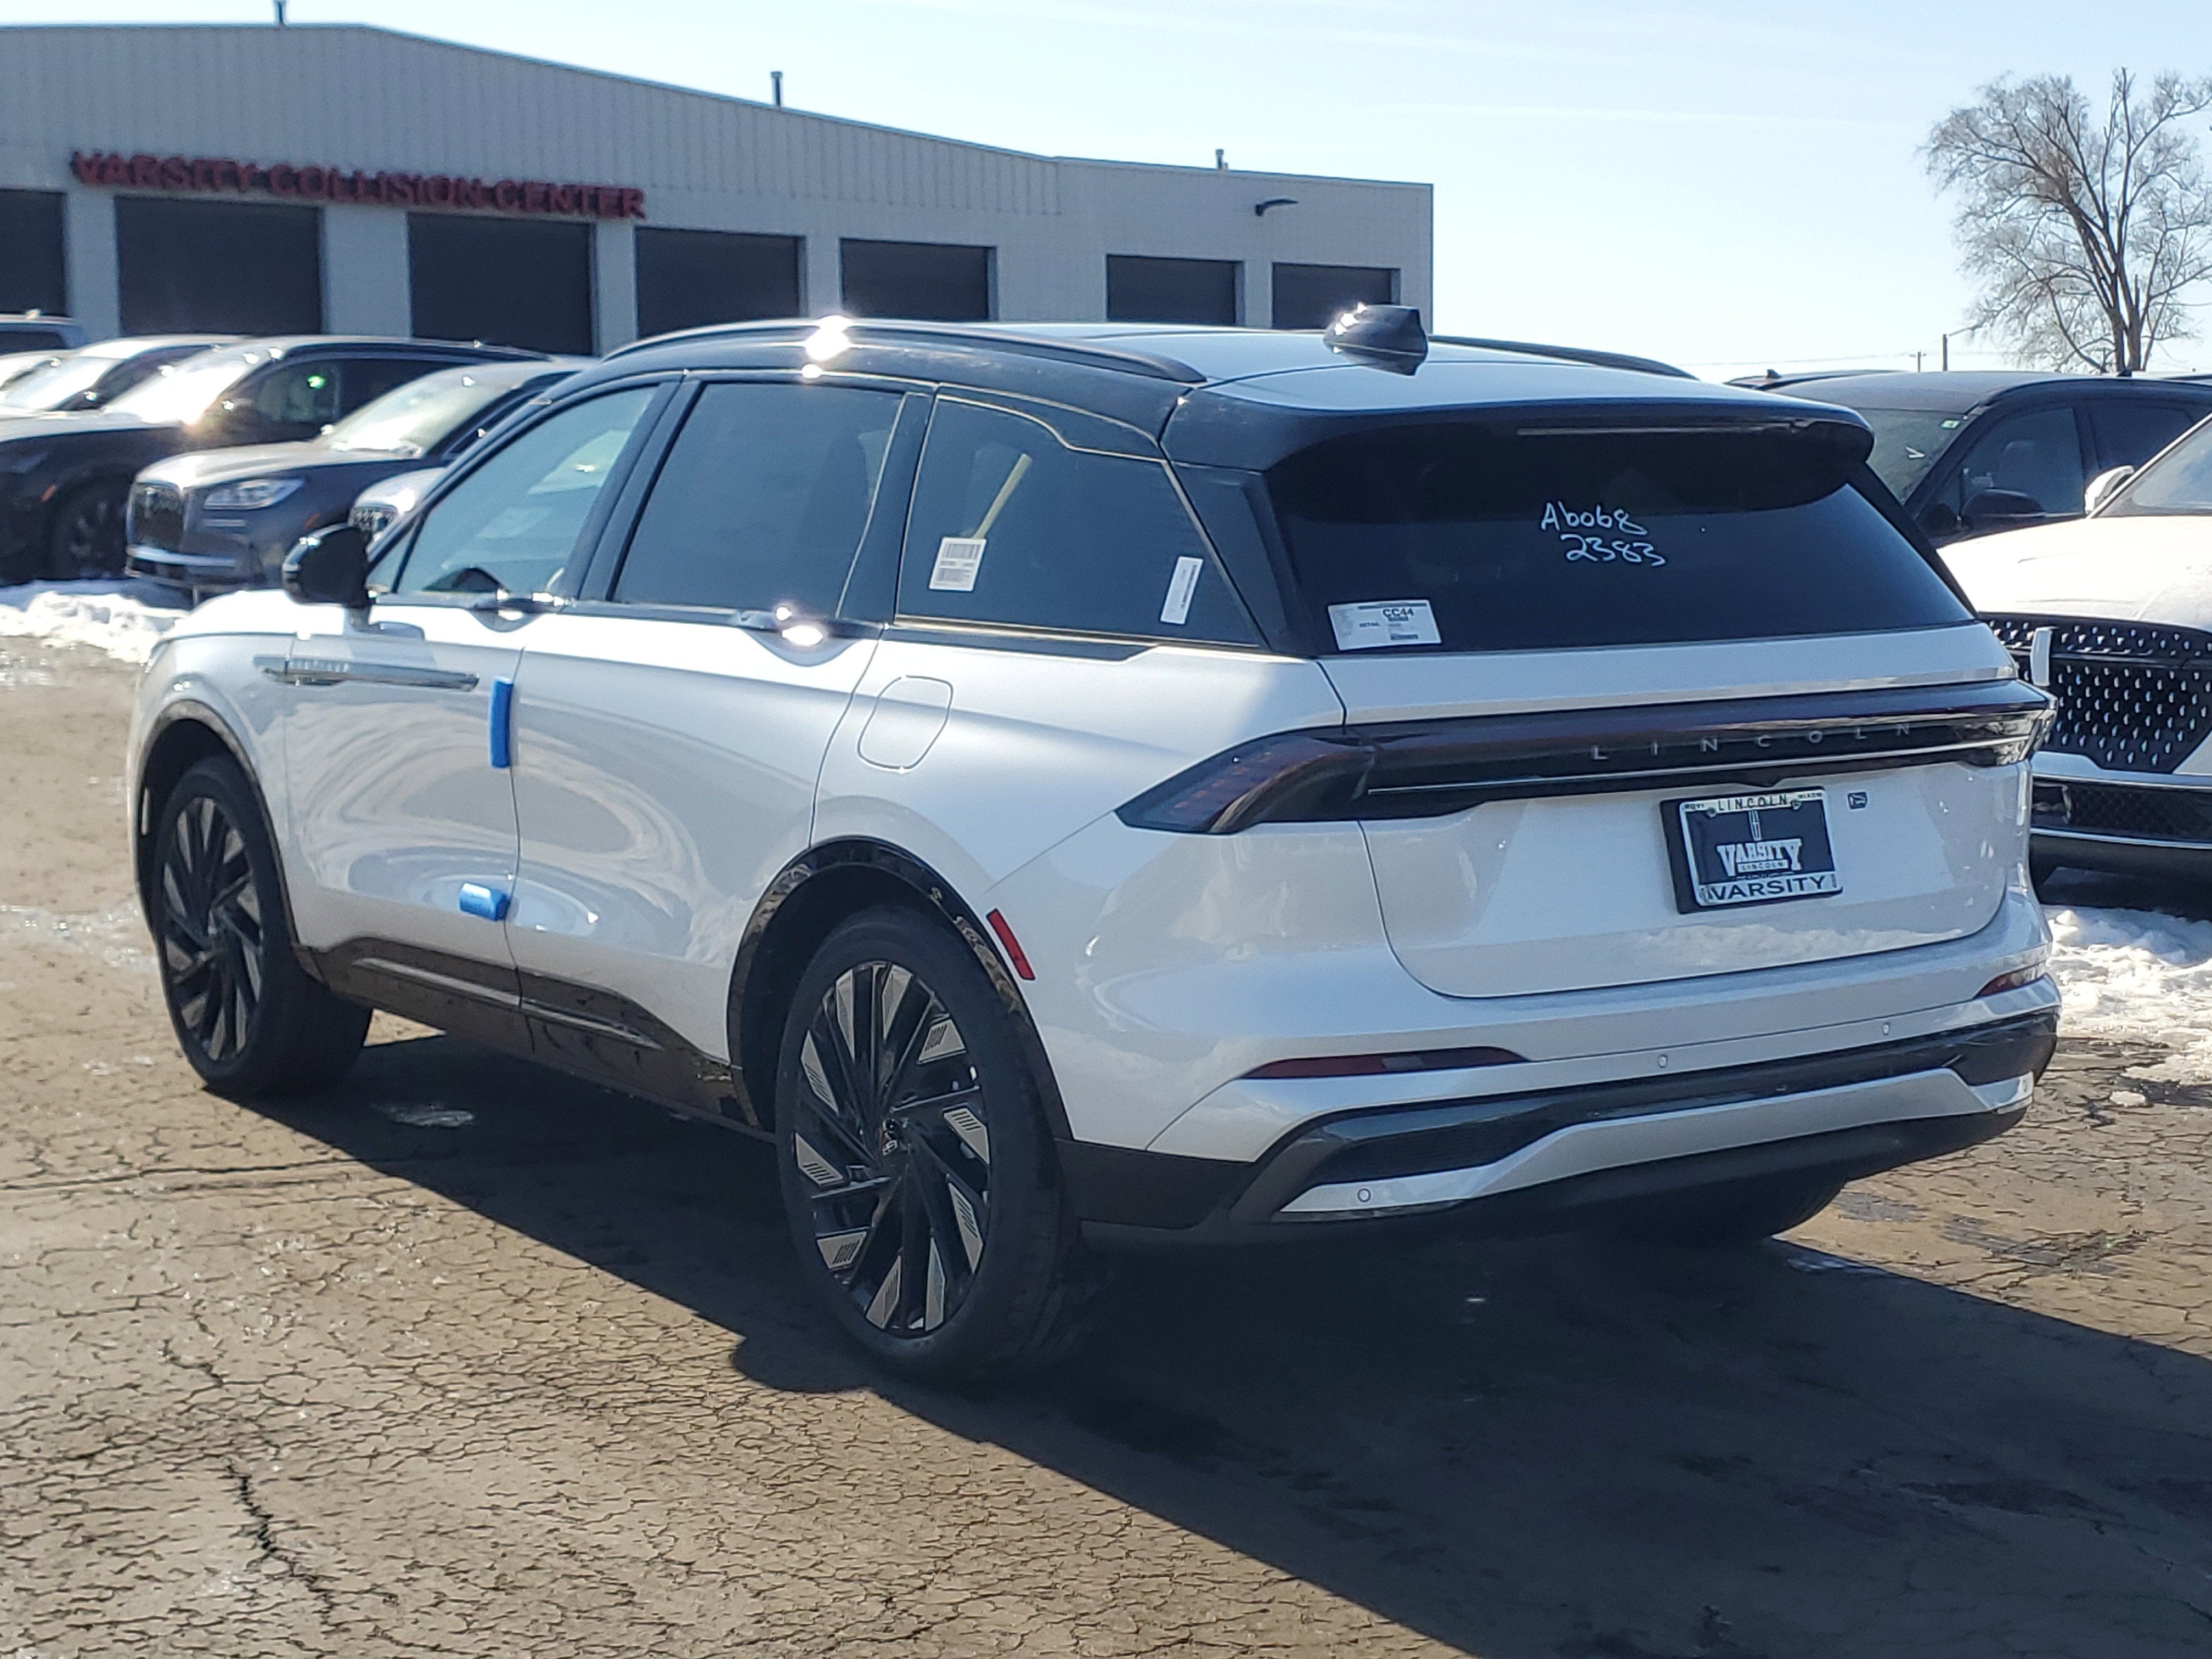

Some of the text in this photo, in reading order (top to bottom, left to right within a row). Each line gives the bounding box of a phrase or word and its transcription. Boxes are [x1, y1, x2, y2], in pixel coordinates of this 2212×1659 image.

[70, 151, 645, 219] VARSITY COLLISION CENTER
[1560, 533, 1666, 566] 2383
[1383, 607, 1414, 617] CC44
[1593, 723, 1910, 760] LINCOLN
[1717, 793, 1788, 811] LINCOLN
[1716, 838, 1802, 877] VARSITY
[1741, 861, 1784, 871] LINCOLN
[1710, 875, 1826, 900] VARSITY
